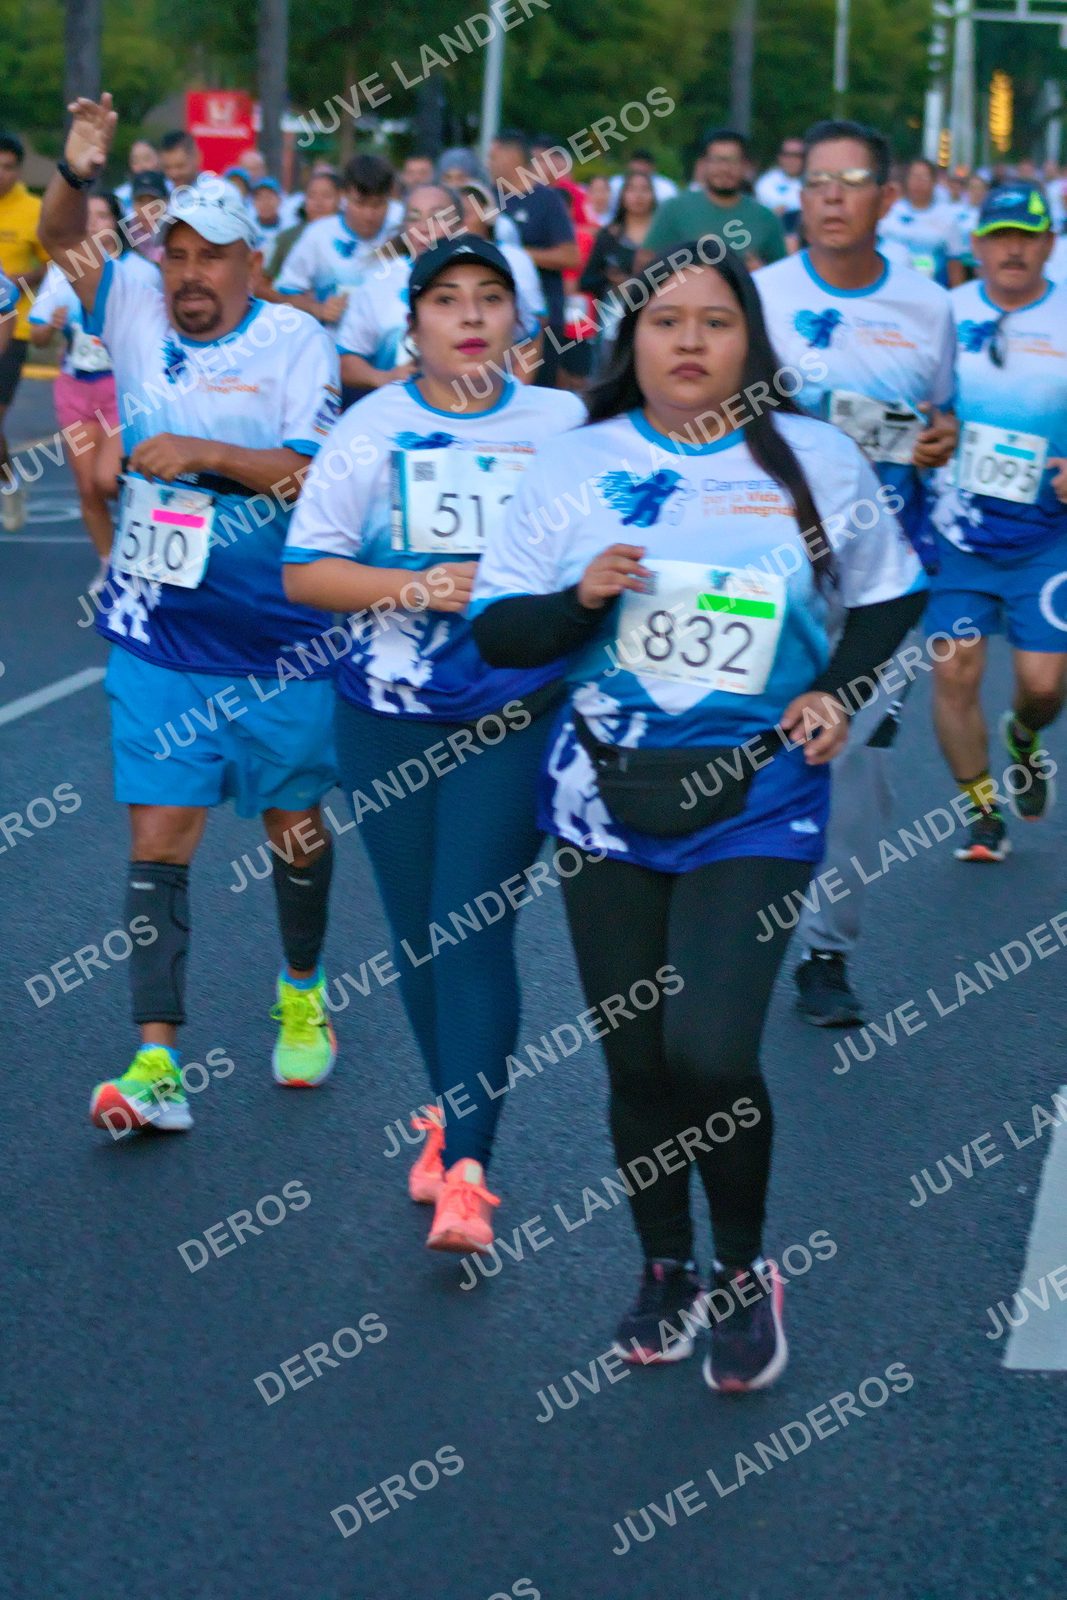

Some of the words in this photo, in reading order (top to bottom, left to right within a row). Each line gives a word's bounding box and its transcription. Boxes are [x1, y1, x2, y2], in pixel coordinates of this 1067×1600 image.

[962, 451, 1038, 494] 1095
[430, 492, 514, 538] 51
[122, 520, 189, 571] 510
[643, 609, 754, 676] 832
